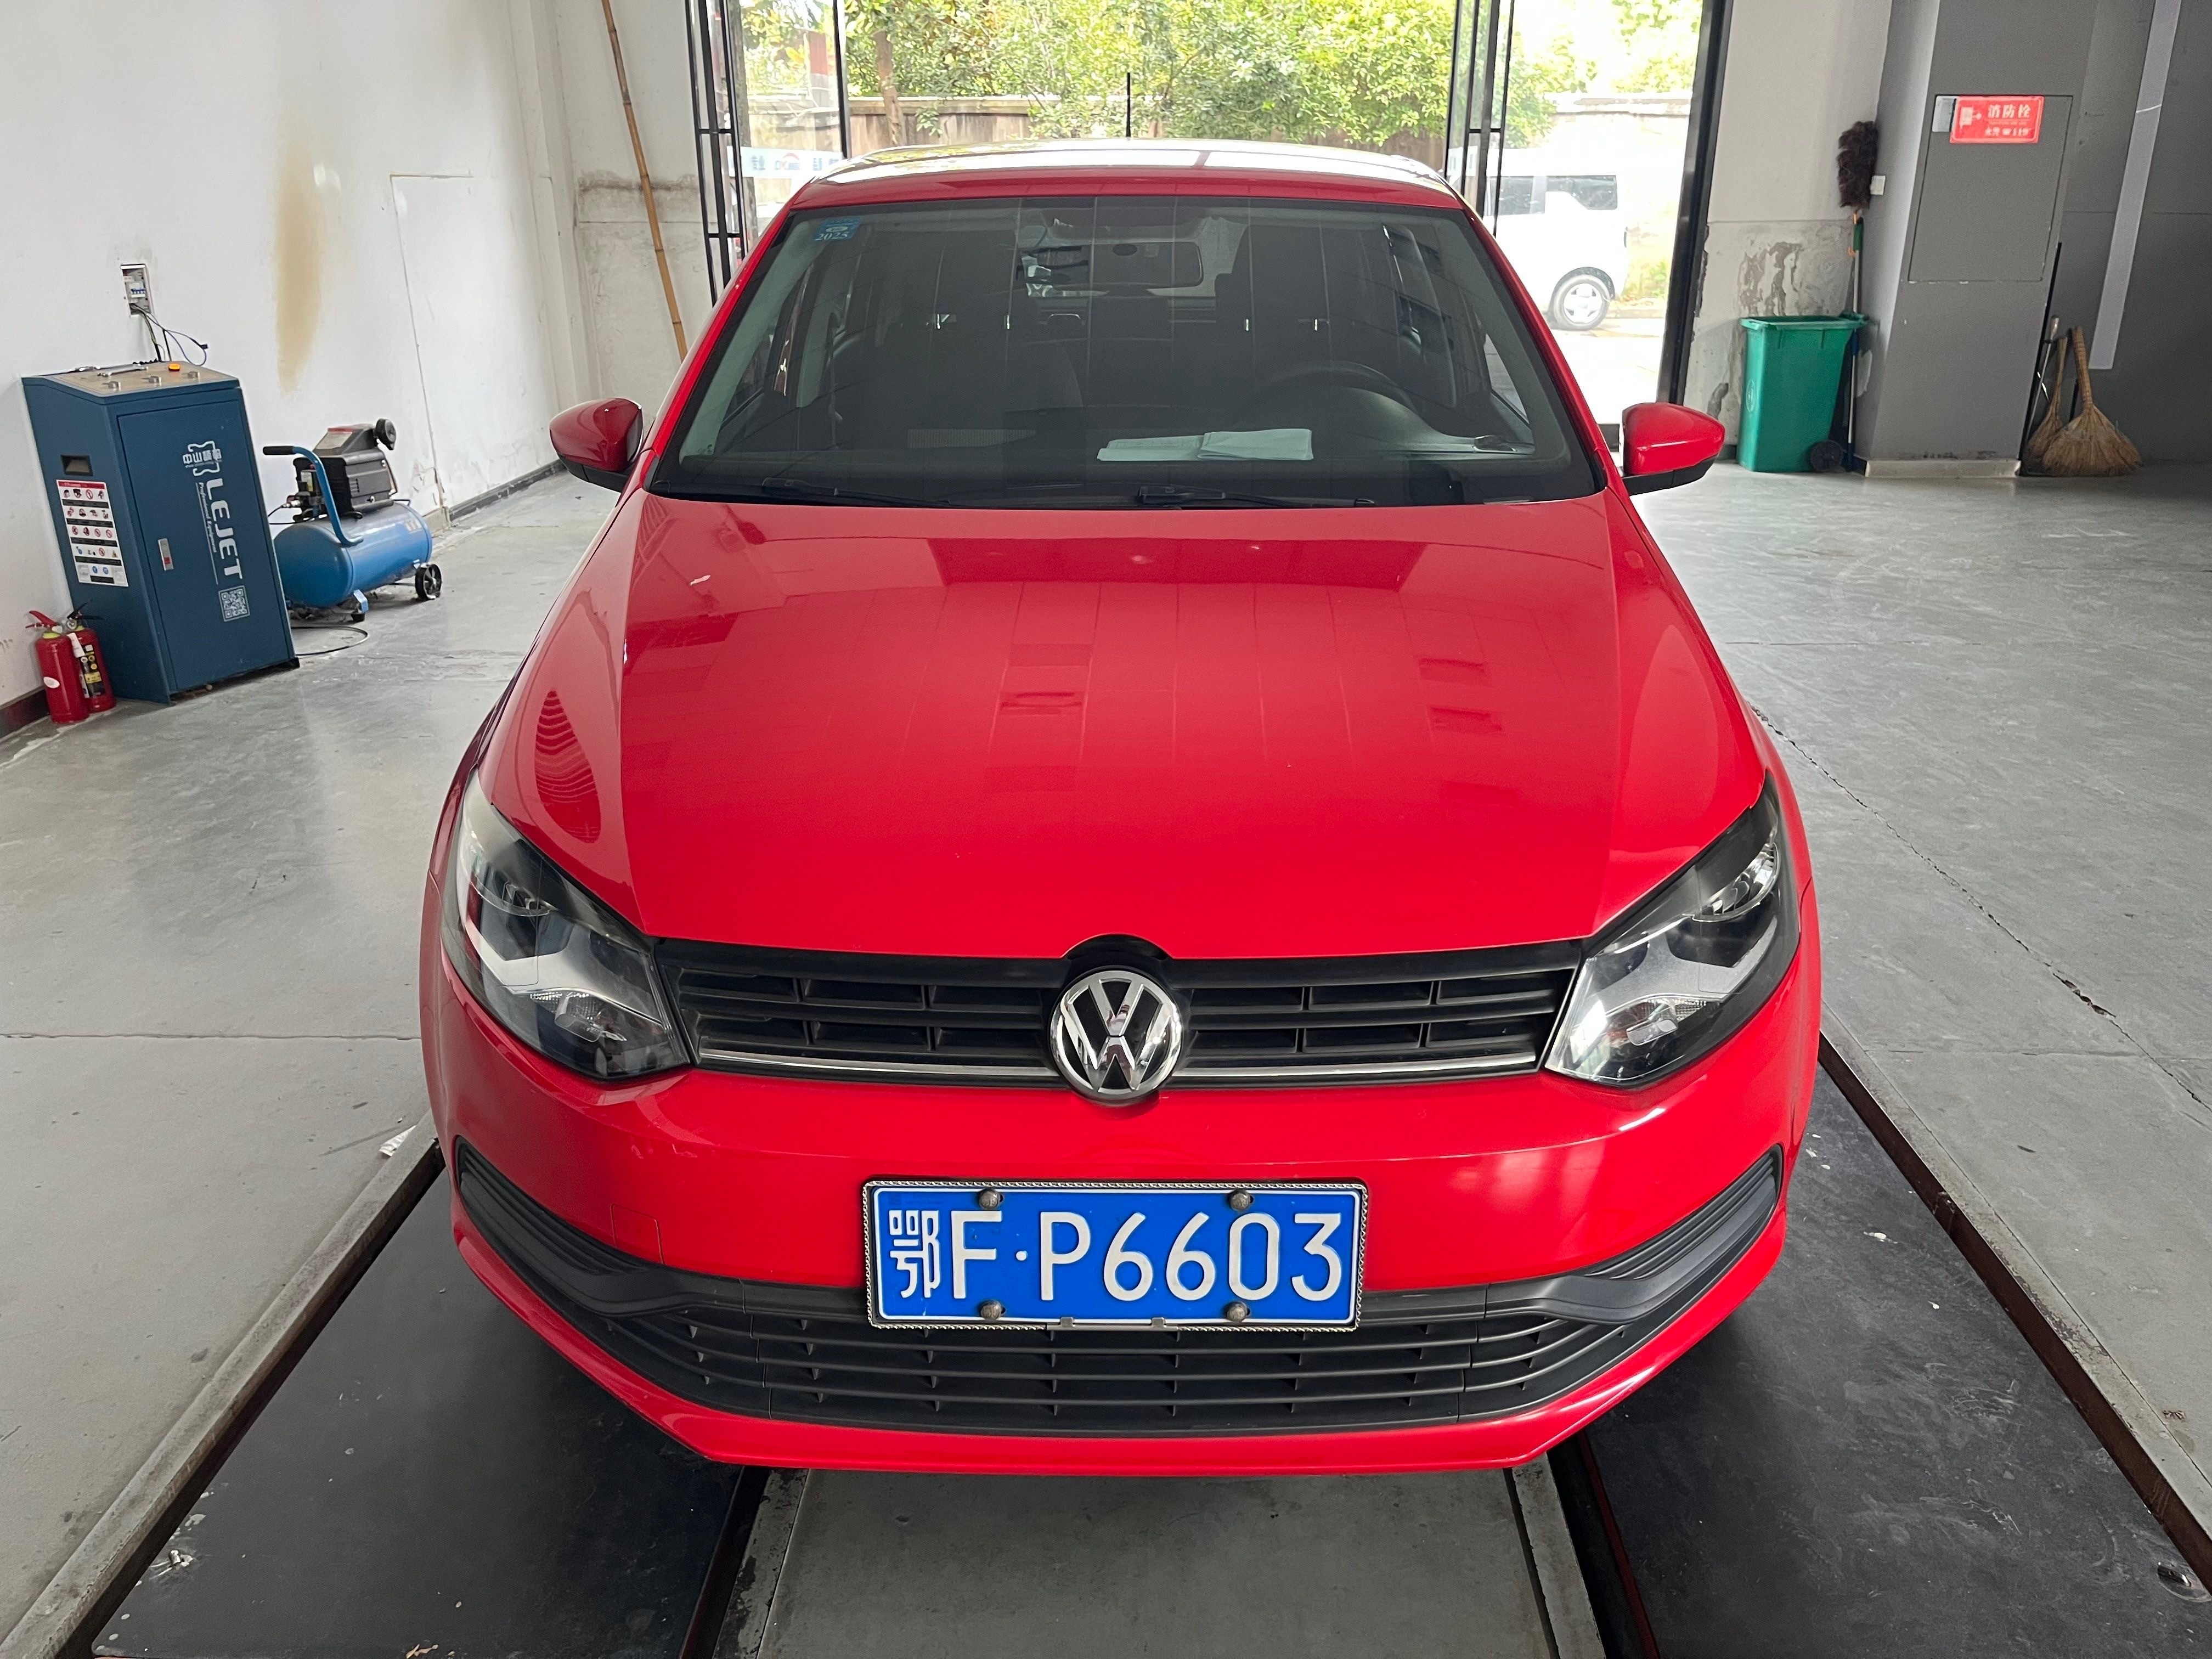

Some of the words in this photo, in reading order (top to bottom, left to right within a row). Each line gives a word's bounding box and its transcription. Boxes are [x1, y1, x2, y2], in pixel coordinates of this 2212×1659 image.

[1988, 104, 2031, 118] 消防栓
[815, 232, 850, 241] 2025
[207, 478, 243, 579] LEJET
[1049, 969, 1183, 1102] VW
[889, 1209, 1342, 1302] 鄂F·P6603
